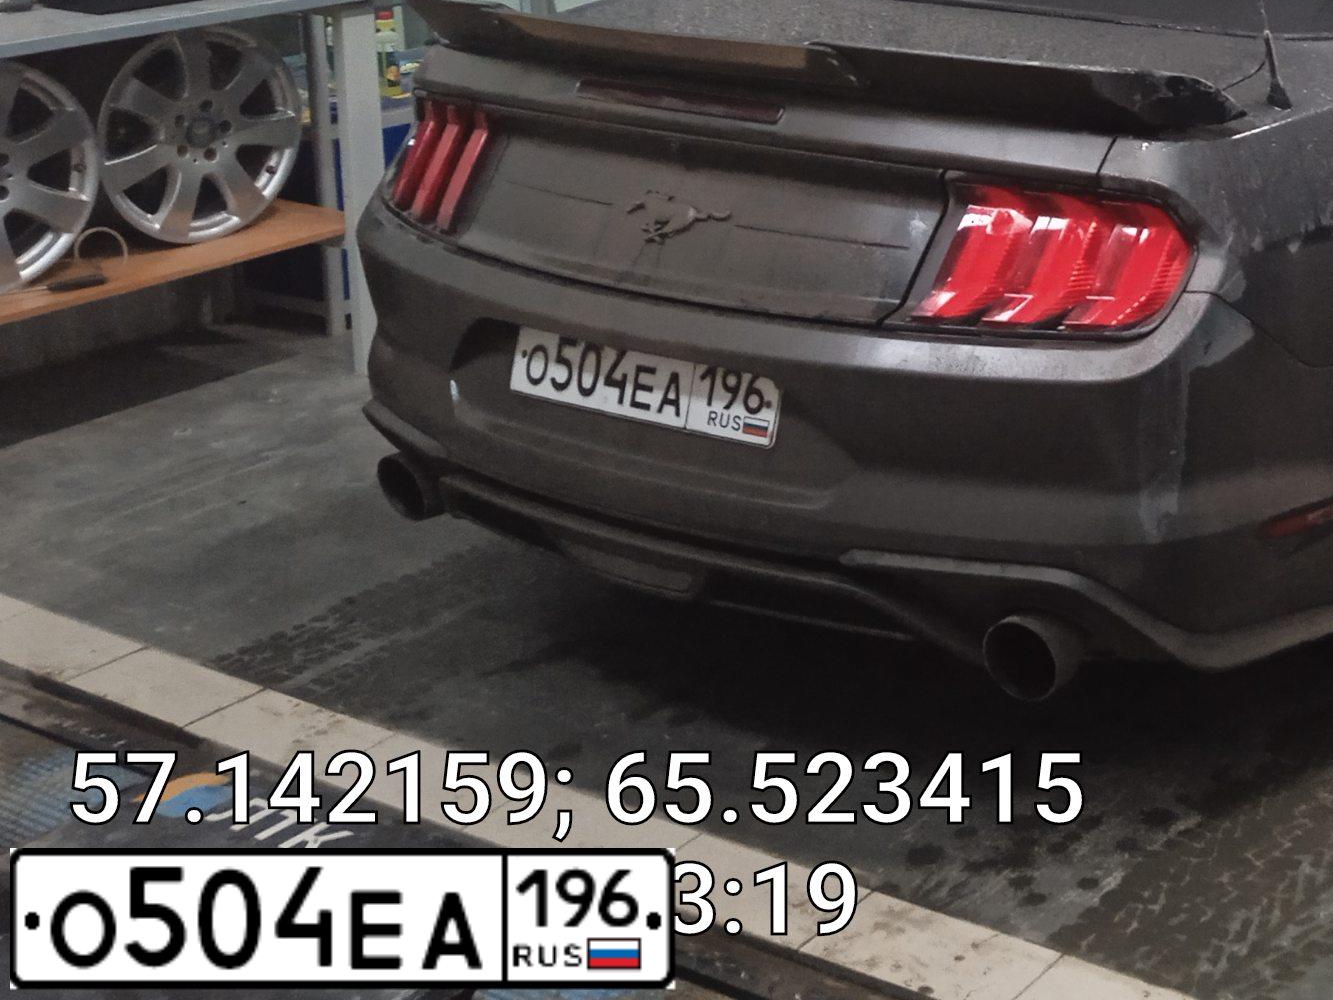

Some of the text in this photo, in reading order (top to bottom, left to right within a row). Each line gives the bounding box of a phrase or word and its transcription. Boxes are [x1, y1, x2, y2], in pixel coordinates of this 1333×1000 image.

[526, 335, 766, 418] О504ЕА 196
[706, 410, 742, 432] RUS
